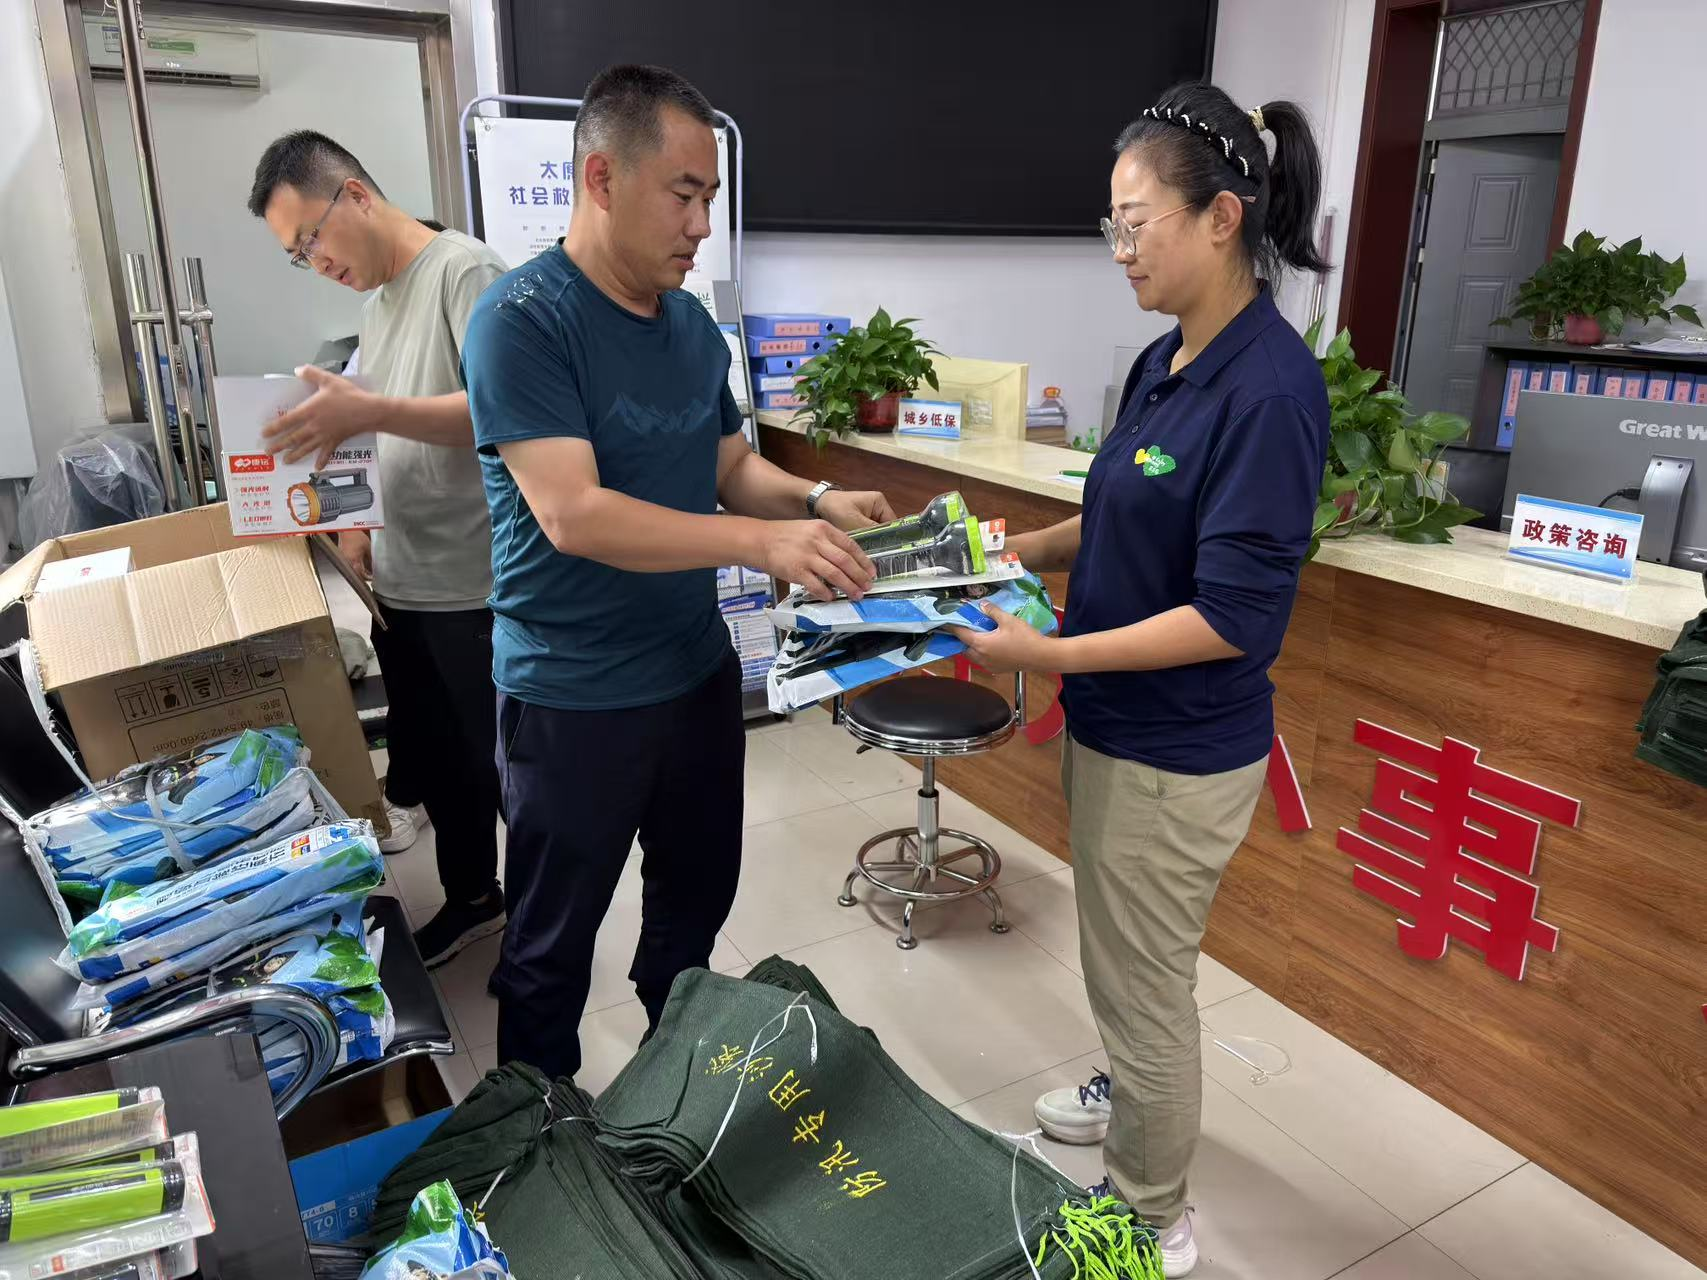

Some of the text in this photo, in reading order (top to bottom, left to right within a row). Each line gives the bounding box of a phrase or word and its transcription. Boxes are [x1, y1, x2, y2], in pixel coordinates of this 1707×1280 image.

[904, 411, 956, 428] 城乡低保
[1619, 418, 1682, 440] Great
[1522, 519, 1628, 560] 政策咨询
[313, 1215, 334, 1232] 70
